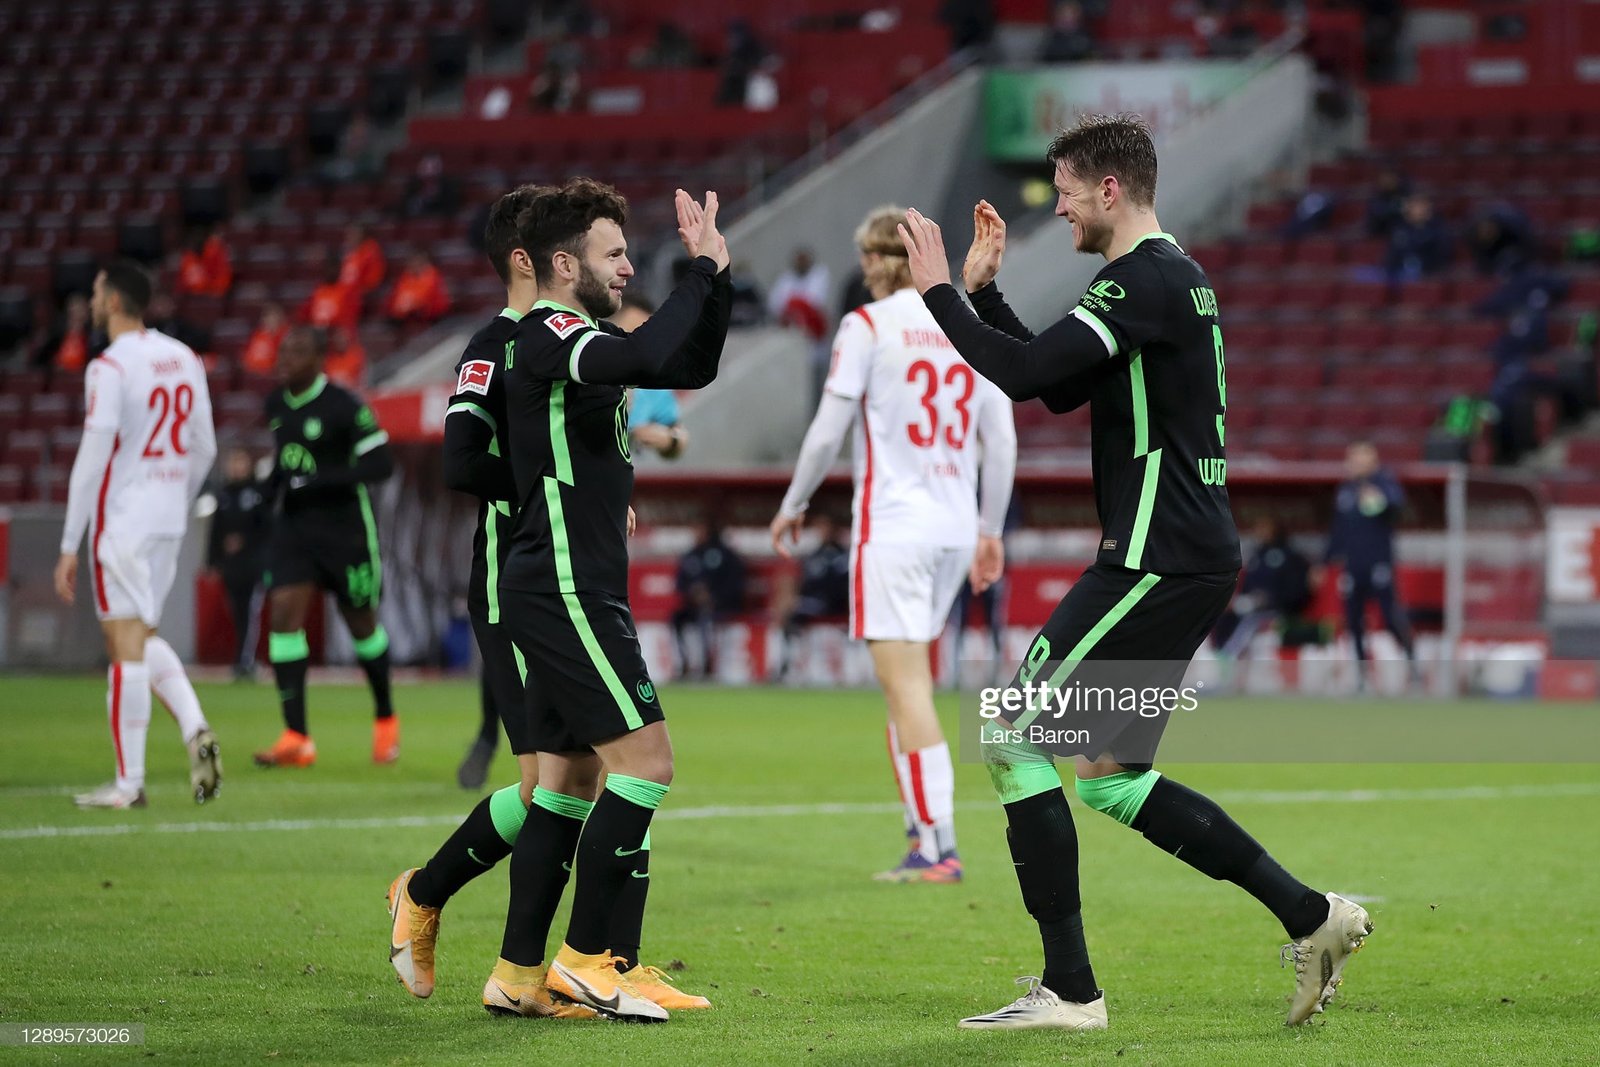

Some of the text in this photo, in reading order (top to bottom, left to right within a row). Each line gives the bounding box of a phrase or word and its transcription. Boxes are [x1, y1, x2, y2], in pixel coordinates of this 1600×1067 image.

[142, 383, 194, 458] 28
[906, 359, 976, 450] 33
[1019, 634, 1051, 690] 9
